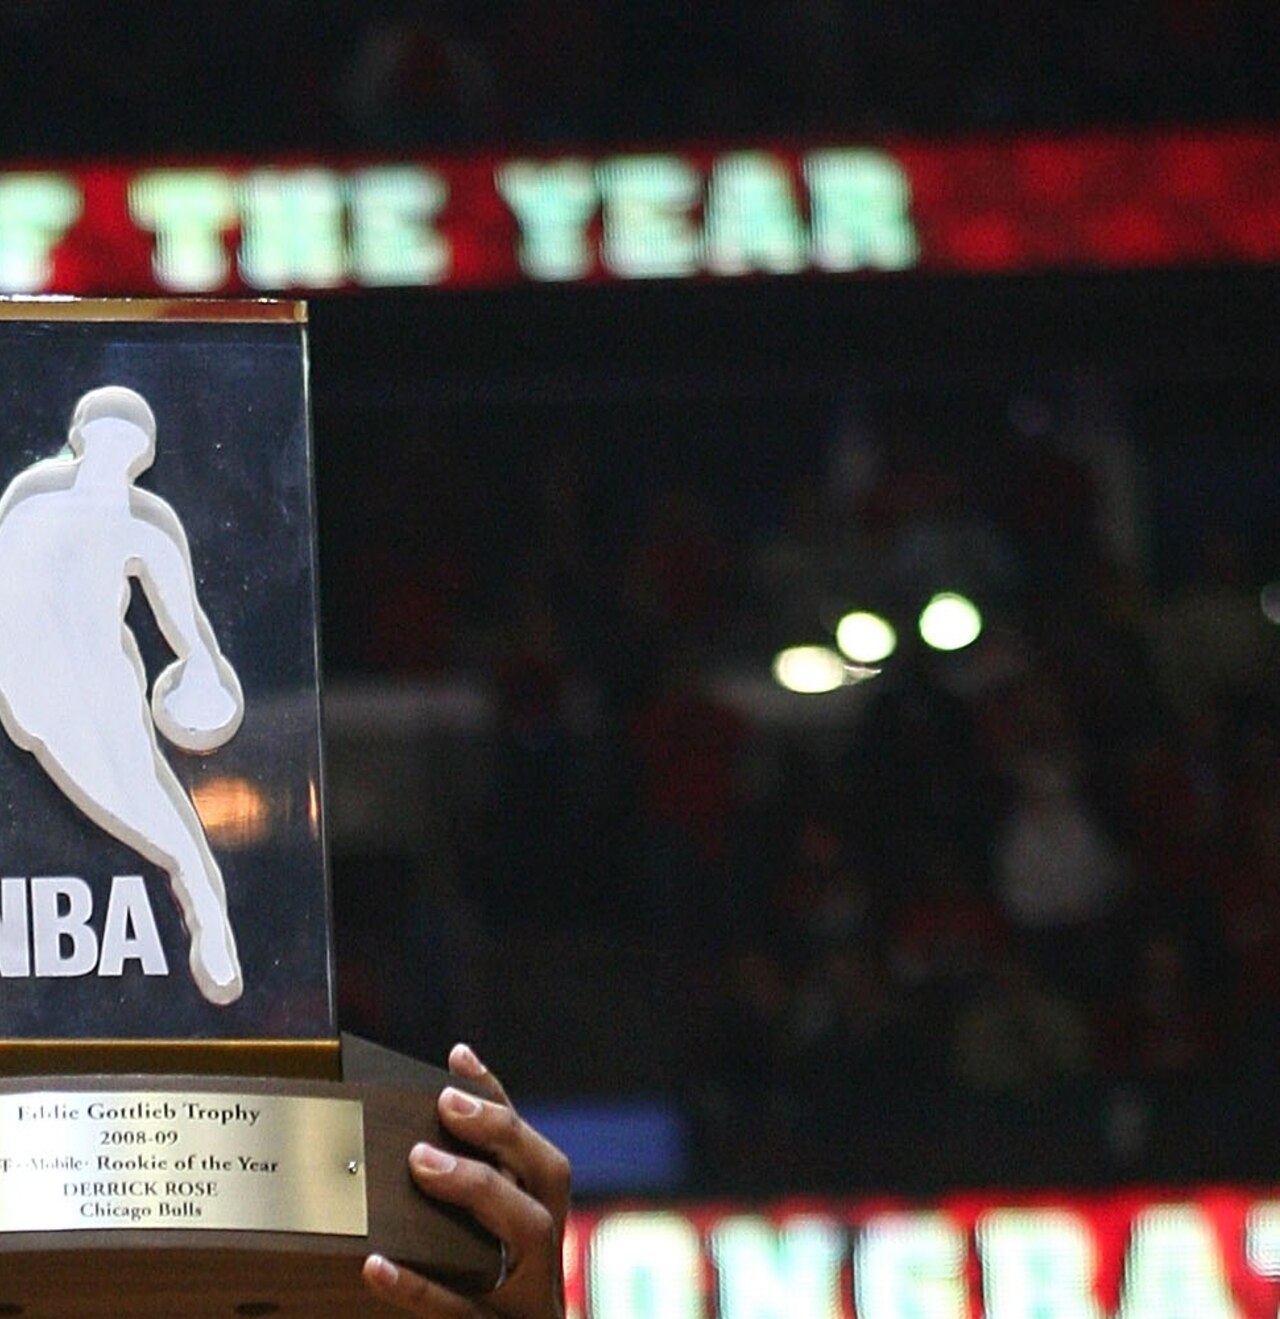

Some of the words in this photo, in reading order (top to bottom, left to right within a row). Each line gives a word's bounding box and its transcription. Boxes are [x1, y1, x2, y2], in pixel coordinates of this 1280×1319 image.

[130, 166, 450, 292] THE
[498, 148, 917, 280] YEAR
[87, 1102, 176, 1121] Gottlieb
[182, 1104, 261, 1126] Trophy
[100, 1130, 179, 1146] 2008-09
[97, 1154, 168, 1171] Rookie
[174, 1153, 196, 1171] of
[201, 1154, 232, 1171] the
[237, 1155, 279, 1173] Year
[63, 1181, 158, 1197] DERRICK
[165, 1181, 219, 1197] ROSE
[80, 1201, 152, 1221] Chicago
[158, 1201, 202, 1217] Bulls
